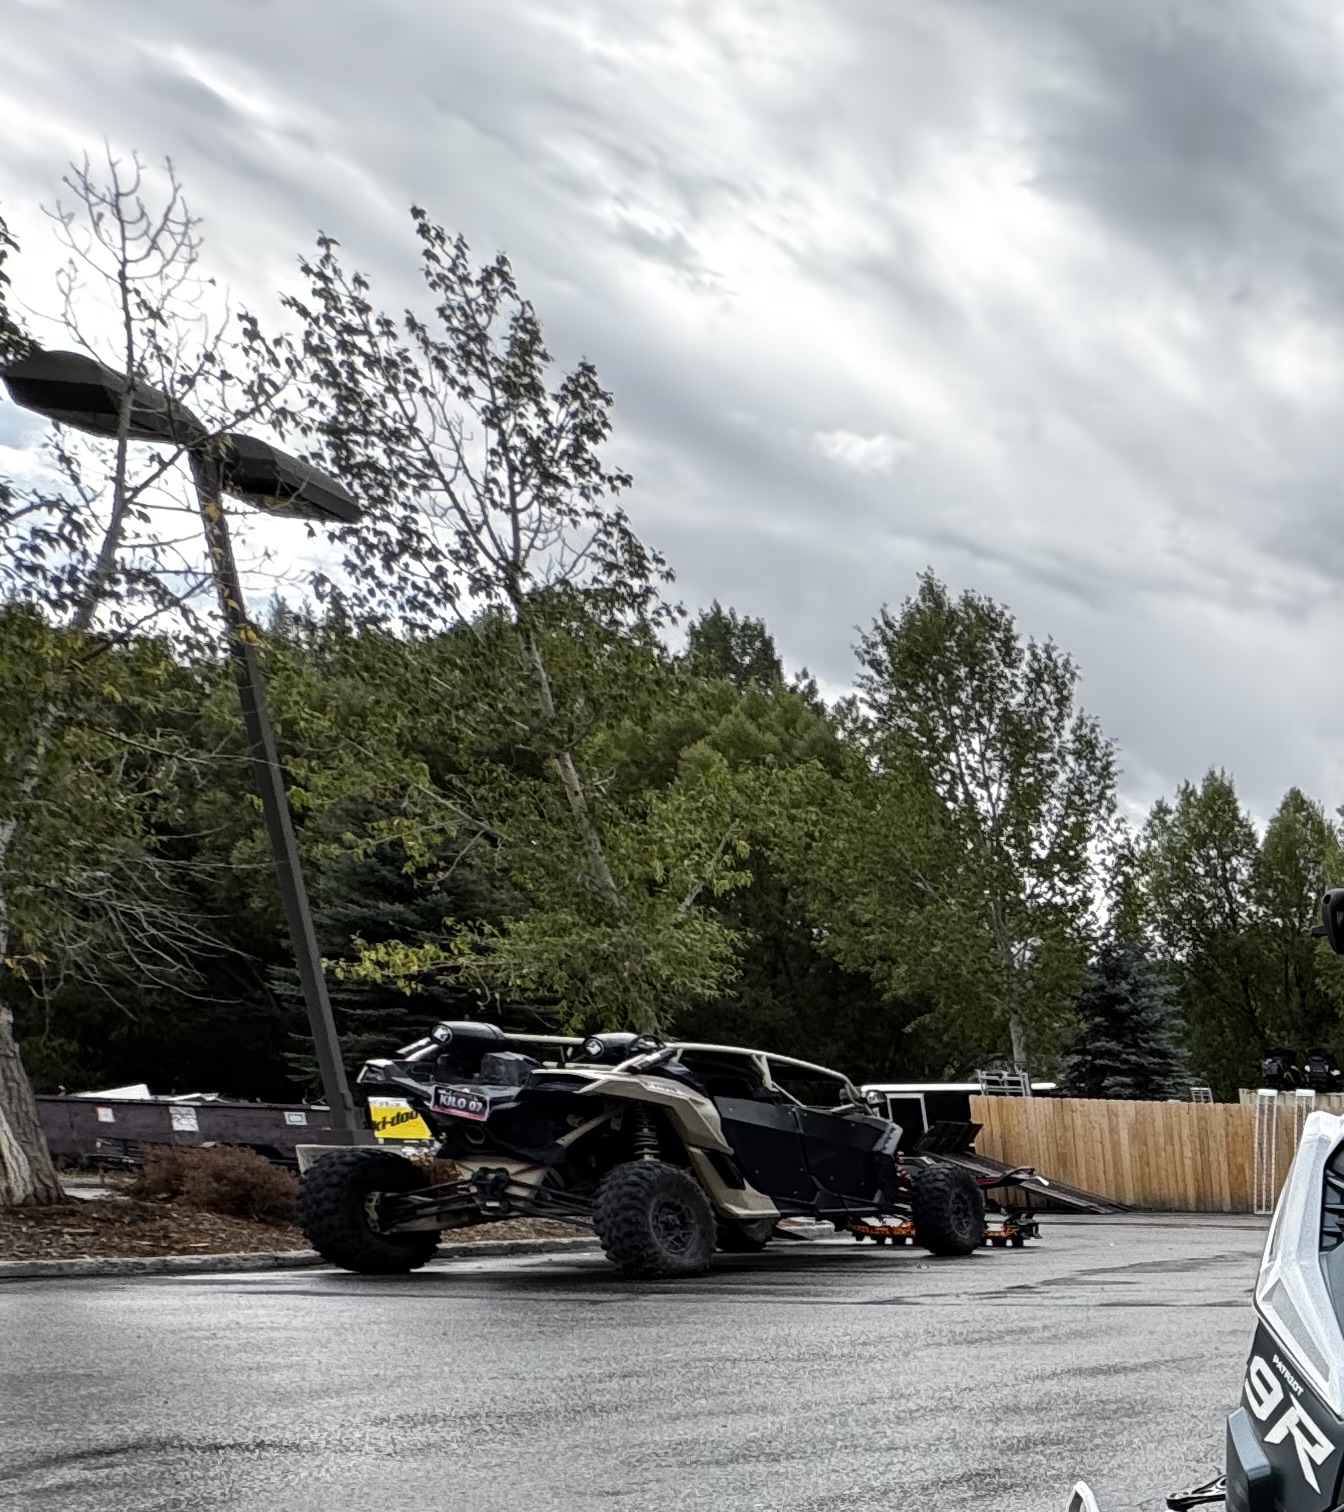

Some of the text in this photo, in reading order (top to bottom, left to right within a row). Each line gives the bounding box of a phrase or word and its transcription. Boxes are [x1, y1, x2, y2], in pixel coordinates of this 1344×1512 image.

[439, 1094, 467, 1110] KILO
[1272, 1353, 1305, 1397] PATRIOT
[1244, 1355, 1336, 1495] 9R
